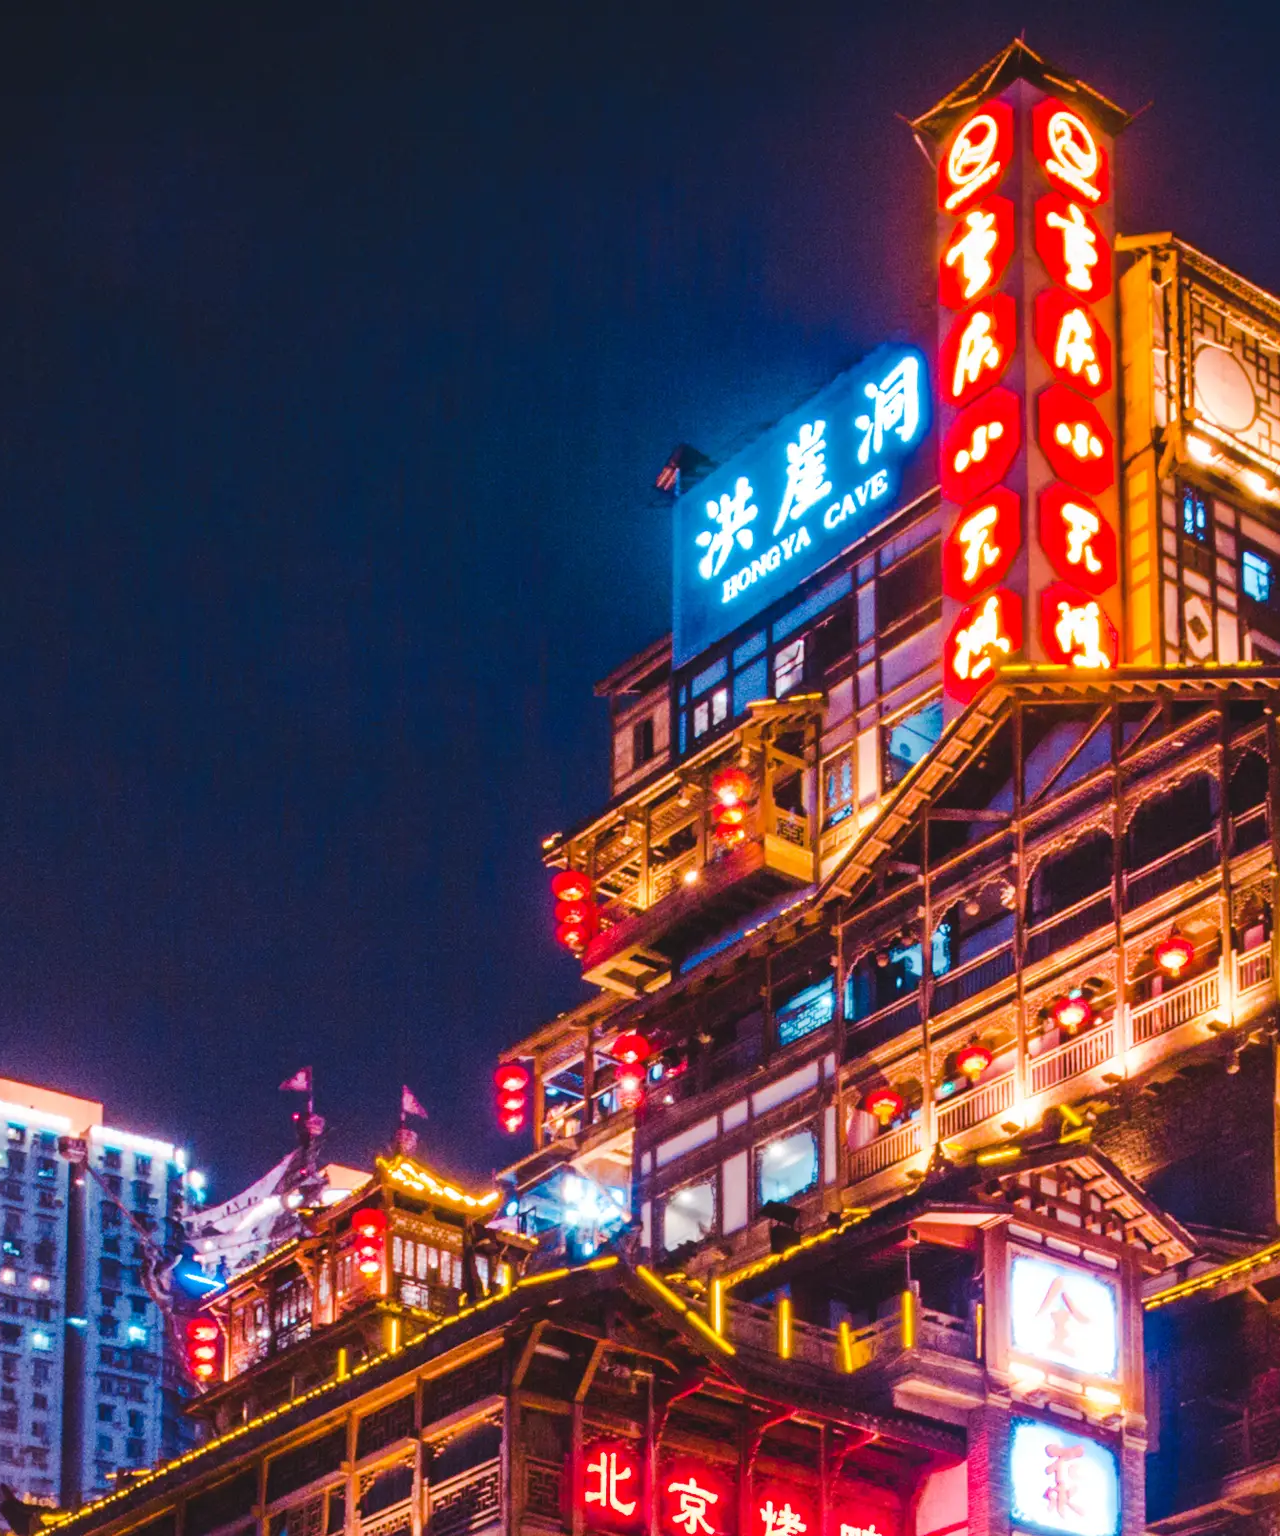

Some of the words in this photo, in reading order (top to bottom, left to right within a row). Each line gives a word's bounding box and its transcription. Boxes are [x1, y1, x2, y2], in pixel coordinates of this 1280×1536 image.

[695, 355, 921, 579] 洪崖洞
[721, 522, 812, 606] HONGYA
[823, 468, 890, 527] CAVE
